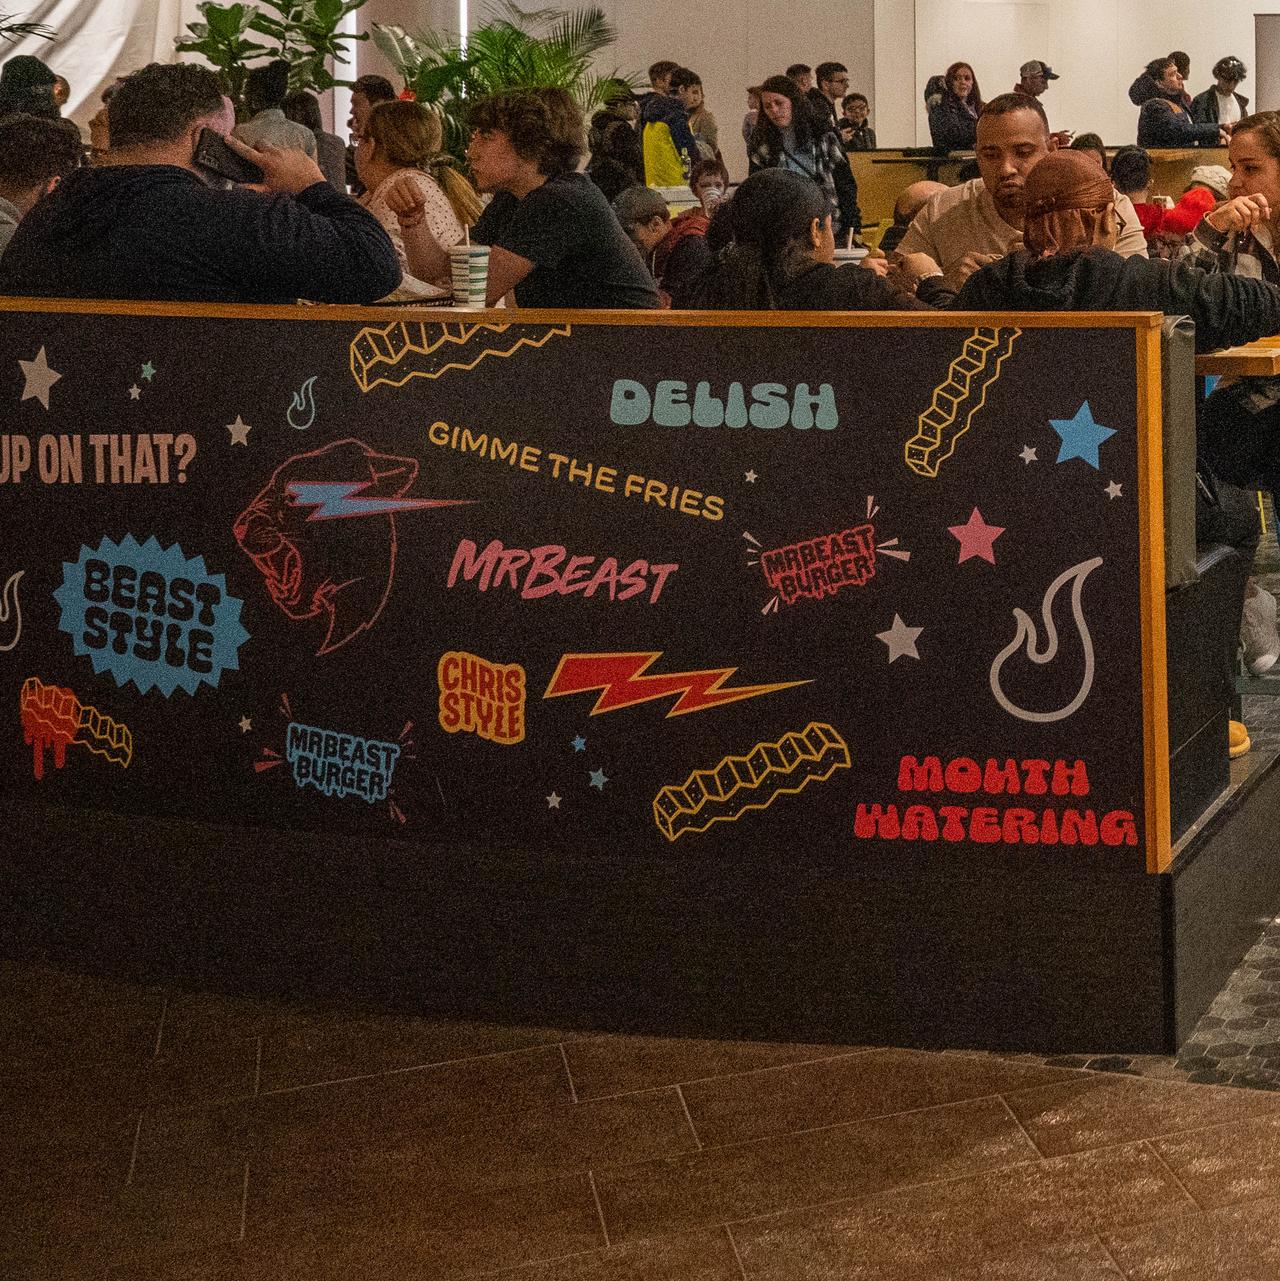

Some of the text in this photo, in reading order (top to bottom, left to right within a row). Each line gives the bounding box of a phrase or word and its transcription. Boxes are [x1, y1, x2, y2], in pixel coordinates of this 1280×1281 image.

[609, 379, 840, 430] DELISH
[38, 434, 83, 484] ON
[89, 433, 198, 484] THAT?
[428, 420, 726, 521] GIMME THE FRIES
[764, 527, 873, 580] MRBEAST
[780, 556, 874, 601] BURGER
[84, 559, 221, 627] BEAST
[83, 606, 215, 674] STYLE
[442, 657, 522, 704] CHRIS
[443, 692, 521, 739] STYLE
[289, 725, 398, 776] MRBEAST
[897, 755, 1091, 797] MOUTH
[296, 755, 386, 799] BURGER
[853, 803, 1138, 846] WATERING
